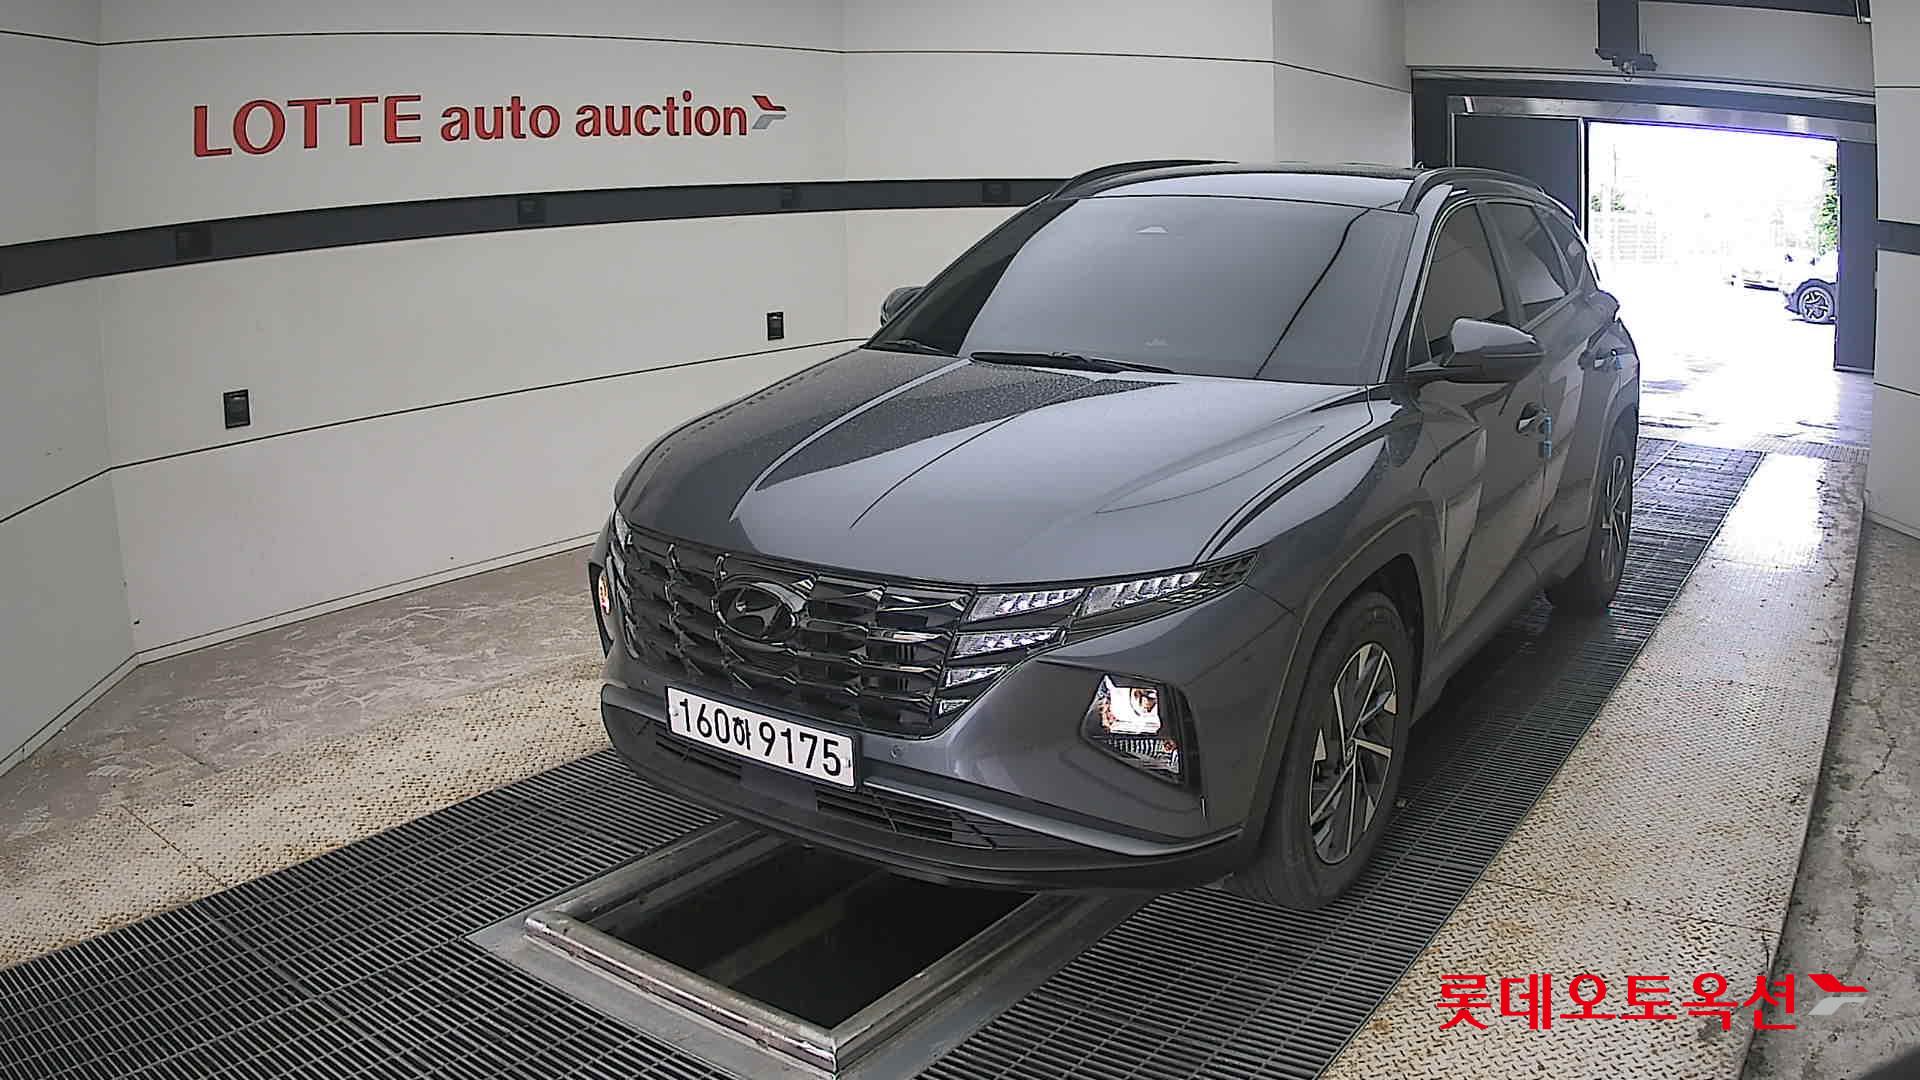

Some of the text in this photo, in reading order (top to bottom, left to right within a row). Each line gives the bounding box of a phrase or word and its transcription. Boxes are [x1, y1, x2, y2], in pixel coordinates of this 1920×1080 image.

[193, 91, 749, 158] LOTTE auto auction
[758, 722, 842, 777] 9175
